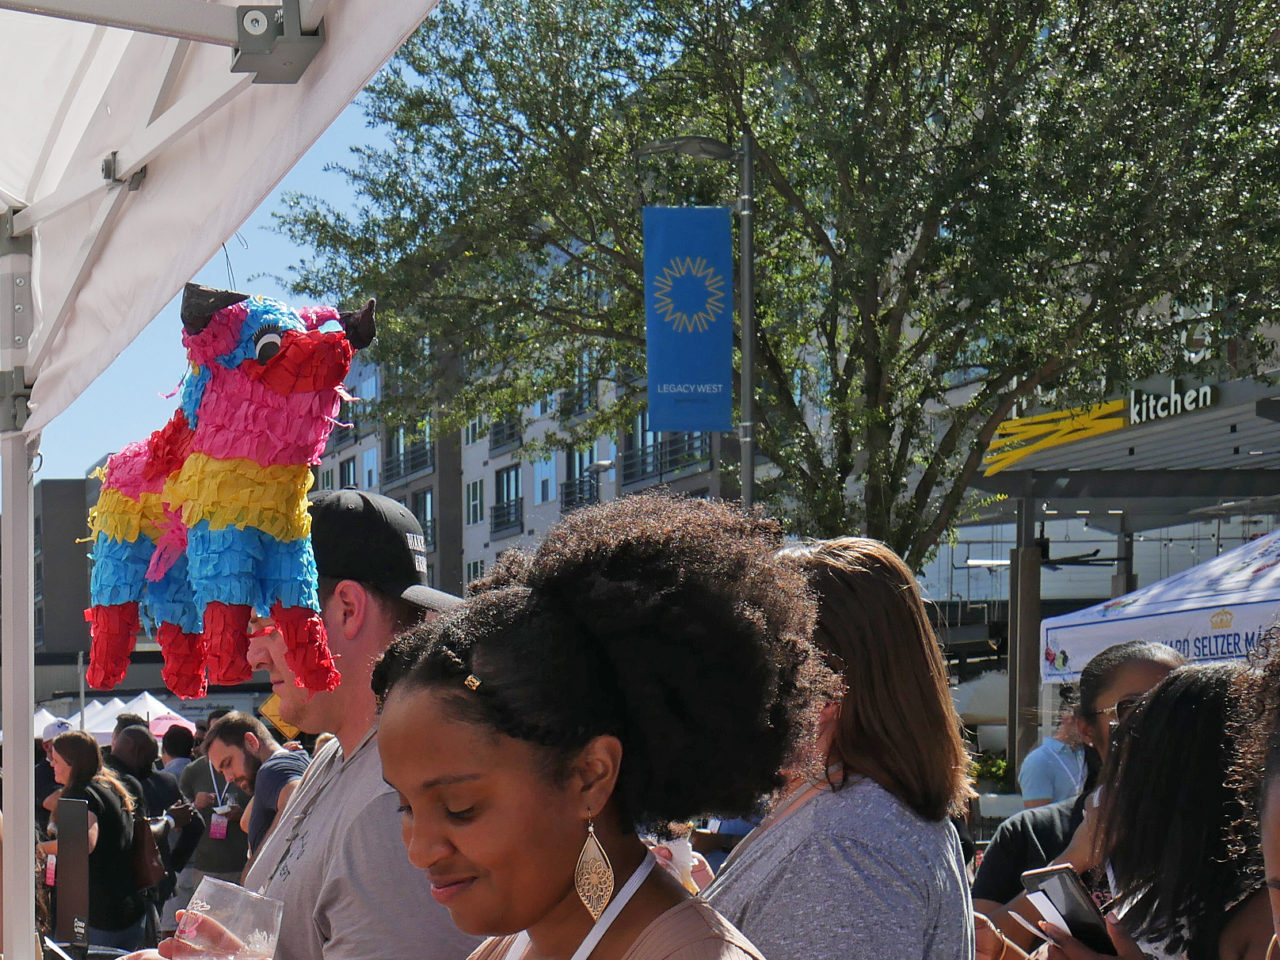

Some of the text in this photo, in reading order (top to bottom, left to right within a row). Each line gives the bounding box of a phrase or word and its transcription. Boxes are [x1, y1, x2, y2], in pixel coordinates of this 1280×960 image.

[657, 383, 723, 393] LEGACY WEST
[1130, 378, 1212, 425] kitchen
[1193, 632, 1241, 657] SELTZER
